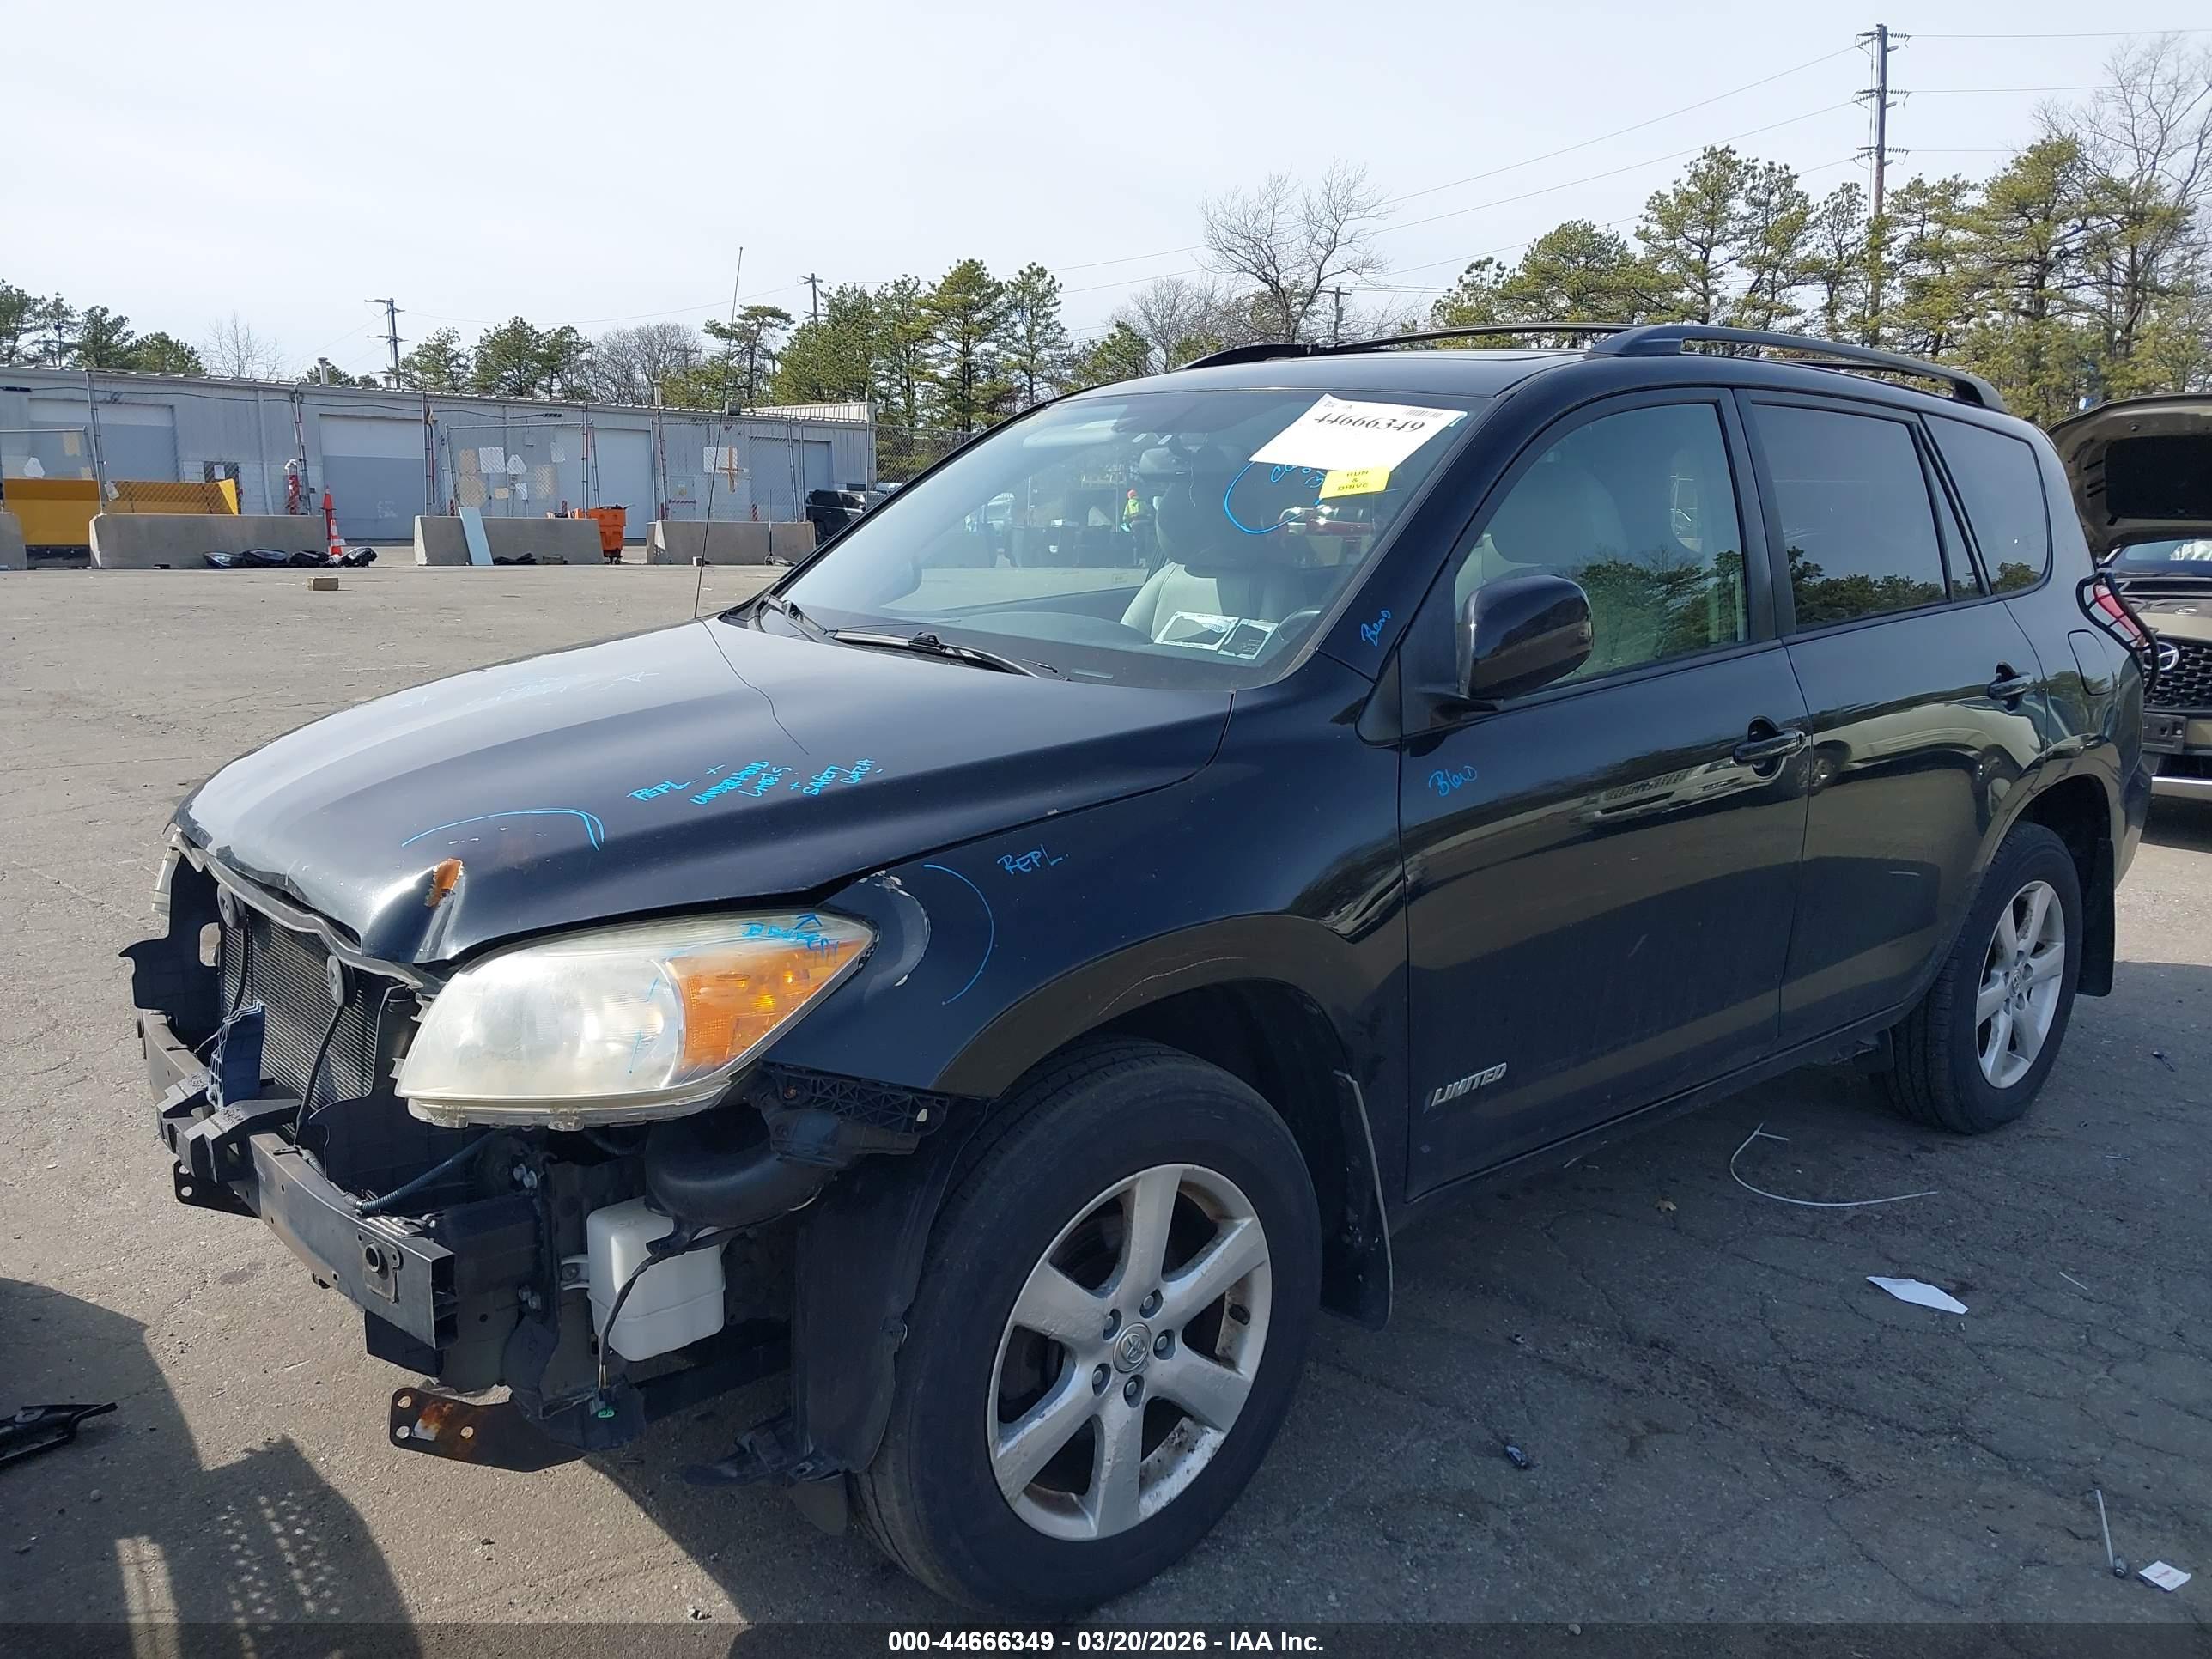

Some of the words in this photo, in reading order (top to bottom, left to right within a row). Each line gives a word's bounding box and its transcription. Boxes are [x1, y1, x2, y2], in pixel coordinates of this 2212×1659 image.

[1315, 413, 1425, 432] 44666349
[1337, 483, 1369, 491] DRIVE
[1431, 1062, 1507, 1107] LIMITED
